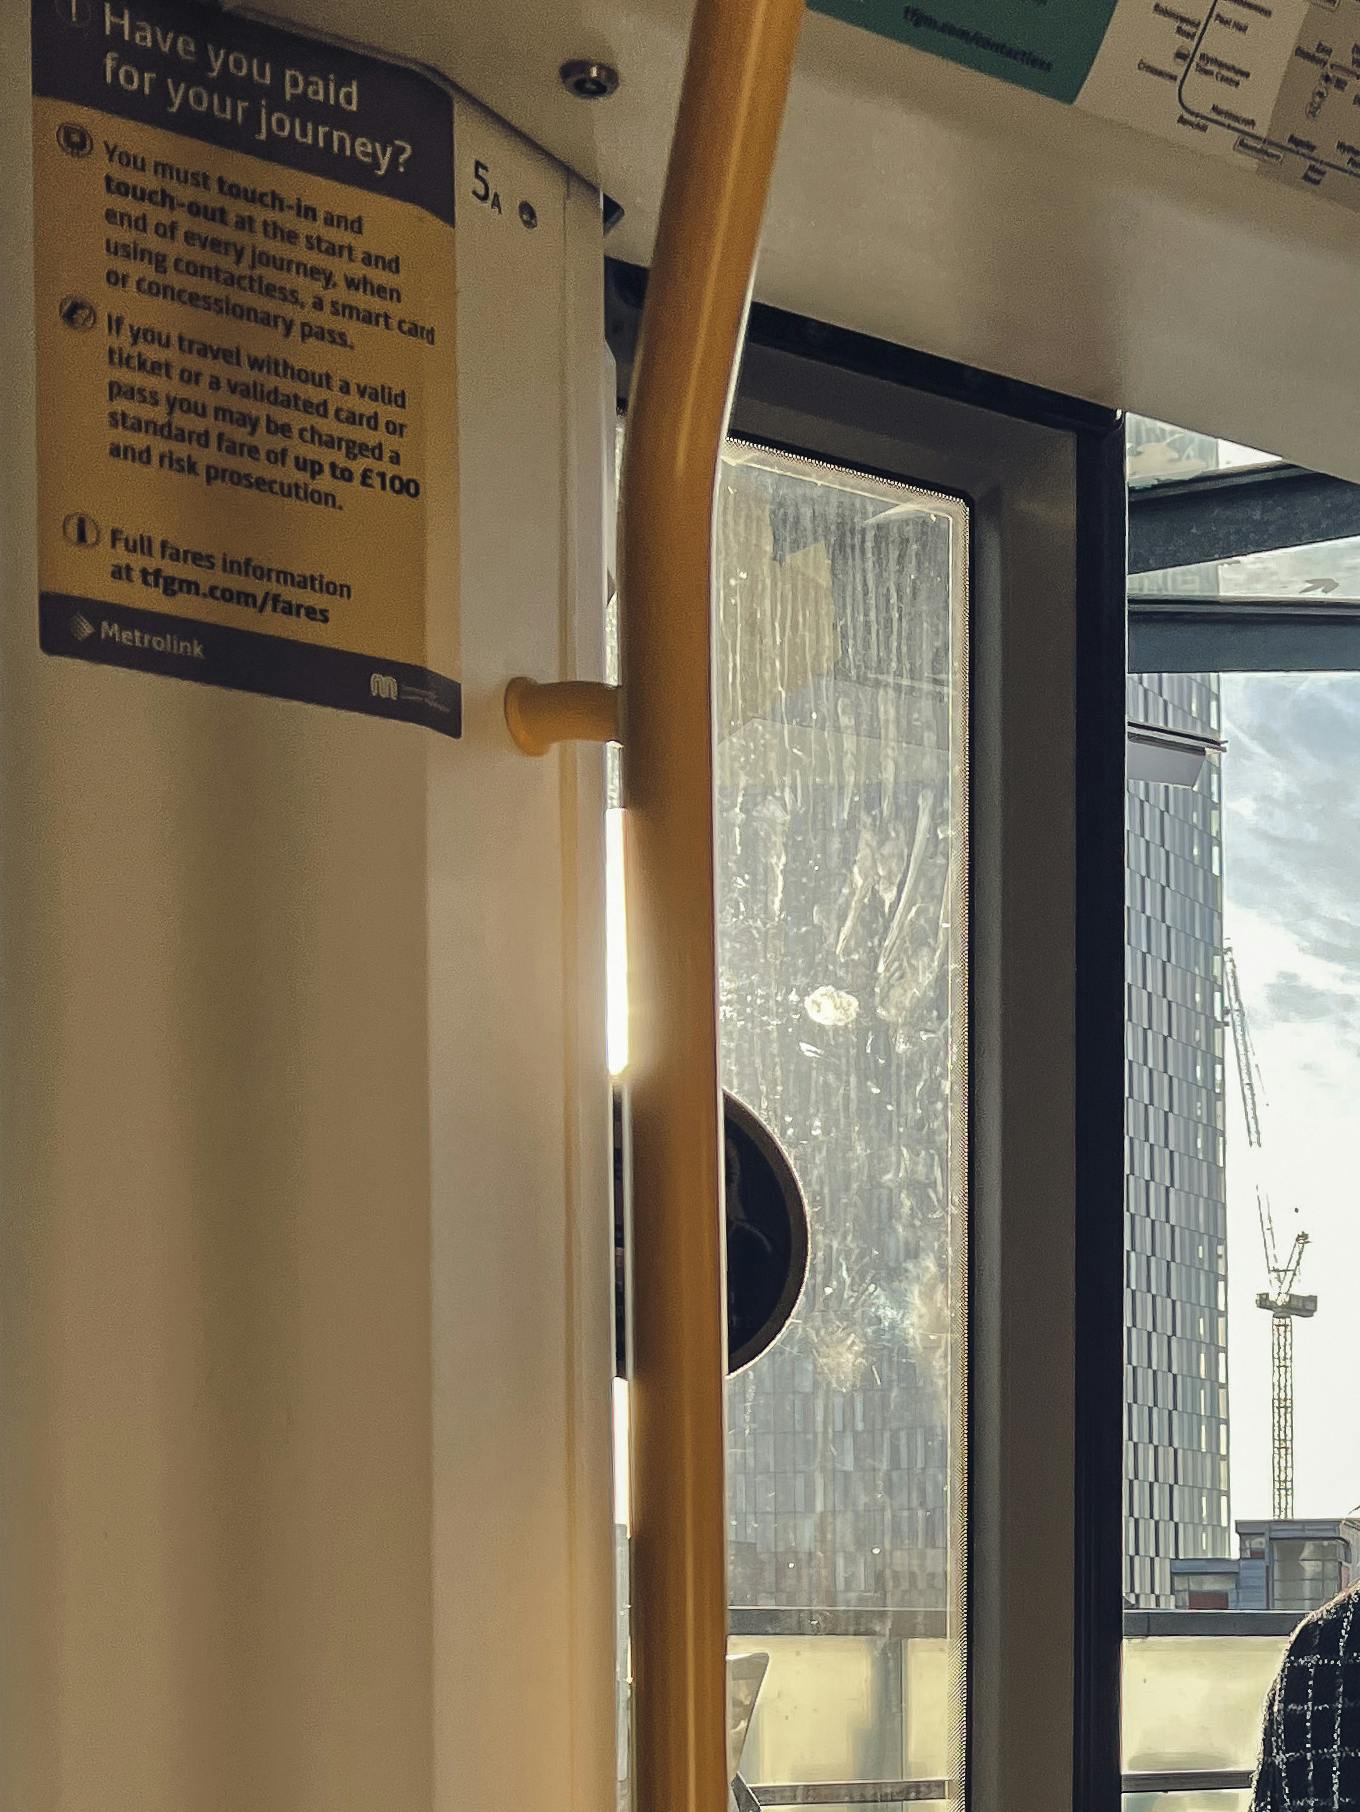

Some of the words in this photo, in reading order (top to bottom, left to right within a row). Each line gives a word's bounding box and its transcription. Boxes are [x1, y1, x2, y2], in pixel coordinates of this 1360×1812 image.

[103, 2, 196, 60] Have
[208, 44, 271, 85] you
[285, 67, 358, 111] paid
[104, 52, 157, 95] for
[168, 77, 249, 125] your
[255, 99, 413, 175] journey?
[103, 141, 147, 173] You
[153, 154, 210, 189] must
[217, 175, 318, 222] touch-in
[323, 206, 364, 236] and
[104, 174, 228, 228] touch-out
[234, 209, 256, 235] at
[262, 214, 298, 246] the
[304, 229, 354, 263] start
[361, 247, 401, 275] and
[104, 238, 168, 273] using
[330, 300, 392, 332] smart
[396, 316, 436, 346] card
[154, 216, 179, 242] of
[183, 230, 246, 265] every
[344, 271, 402, 303] when
[105, 270, 130, 290] or
[136, 273, 294, 339] concessionary
[300, 322, 355, 351] pass.
[106, 312, 124, 338] If
[128, 322, 172, 350] you
[177, 333, 242, 367] travel
[247, 348, 332, 390] without
[355, 377, 407, 409] valid
[107, 347, 172, 381] ticket
[179, 369, 204, 388] or
[226, 376, 329, 420] validated
[333, 399, 378, 431] card
[385, 417, 408, 439] or
[107, 382, 160, 406] pass
[166, 388, 207, 421] you
[213, 407, 259, 436] may
[265, 410, 293, 439] be
[299, 418, 383, 460] charged
[107, 409, 210, 450] standard
[216, 432, 261, 462] fare
[265, 441, 289, 468] of
[293, 454, 324, 481] up
[329, 460, 354, 484] to
[359, 468, 421, 499] £100
[108, 440, 152, 467] and
[158, 449, 200, 477] risk
[205, 464, 344, 511] prosecution.
[110, 528, 153, 559] Full
[160, 538, 216, 571] fares
[221, 553, 352, 600] information
[110, 561, 134, 584] at
[140, 567, 331, 625] tfgm.com/fares
[100, 621, 206, 659] Metrolink
